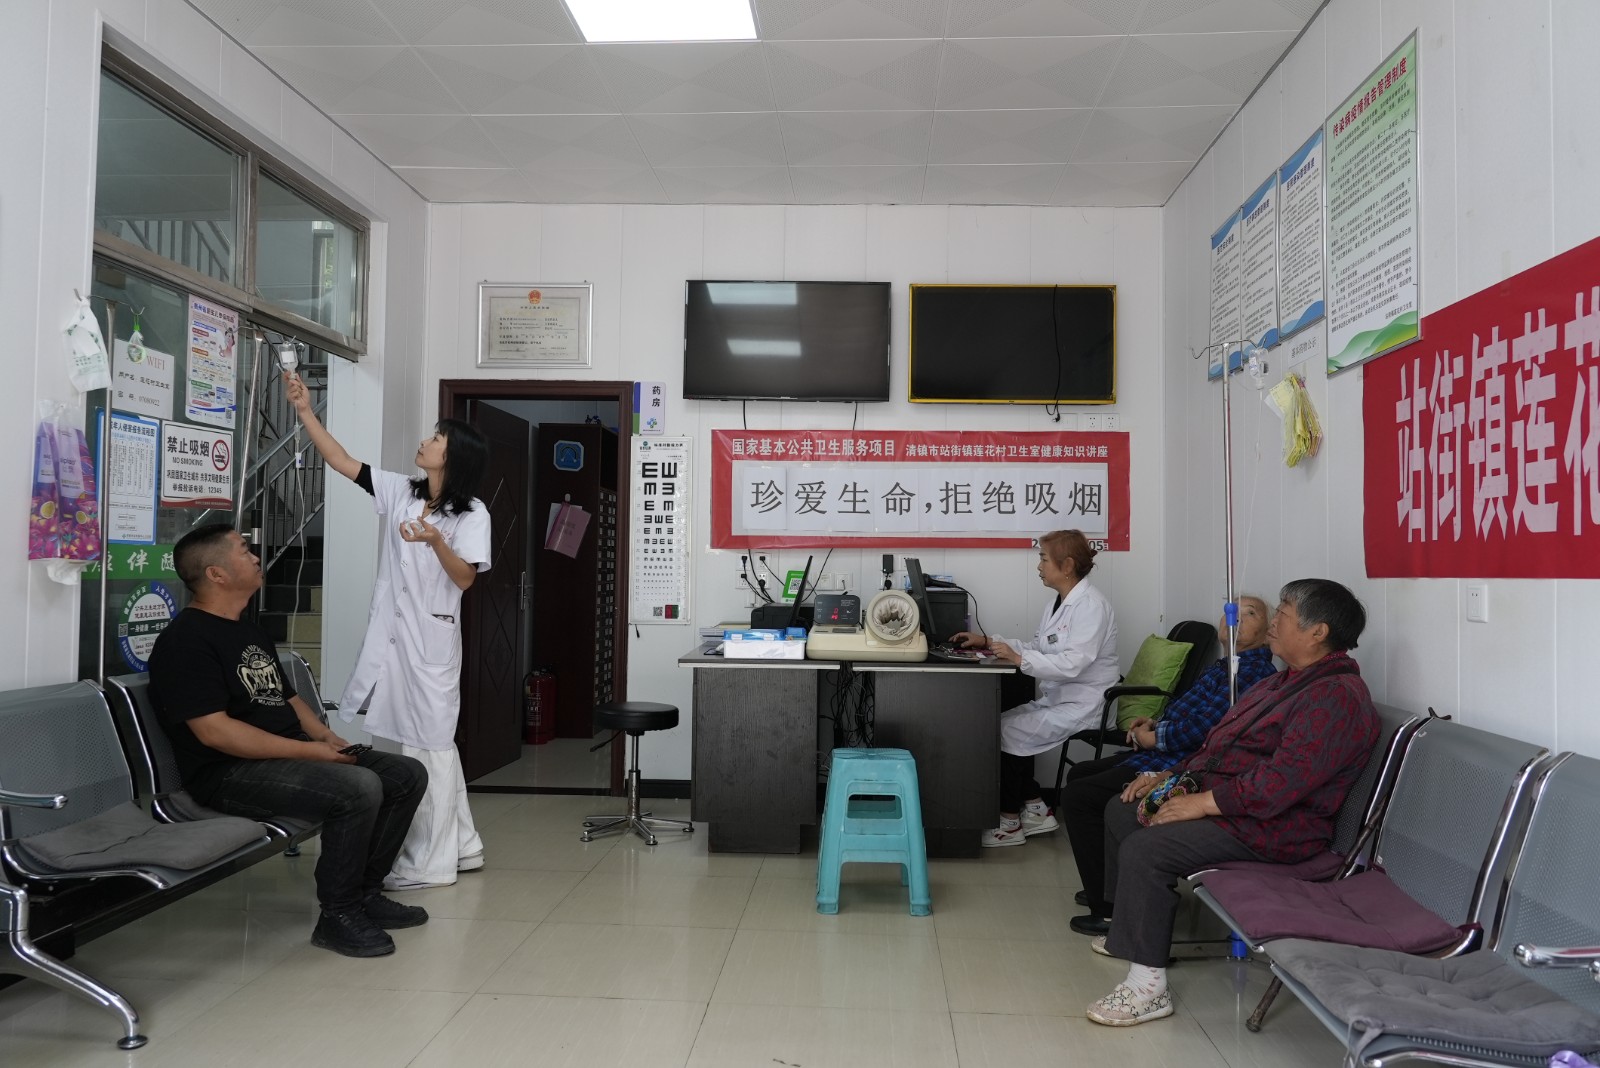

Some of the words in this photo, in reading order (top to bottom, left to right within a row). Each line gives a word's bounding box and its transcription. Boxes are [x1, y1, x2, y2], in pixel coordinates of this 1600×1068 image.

[651, 385, 661, 407] 药房
[167, 436, 210, 457] 禁止吸烟
[732, 438, 895, 457] 国家基本公共卫生服务项目
[905, 443, 1108, 458] 清镇市站街镇莲花村卫生室健康知识讲座
